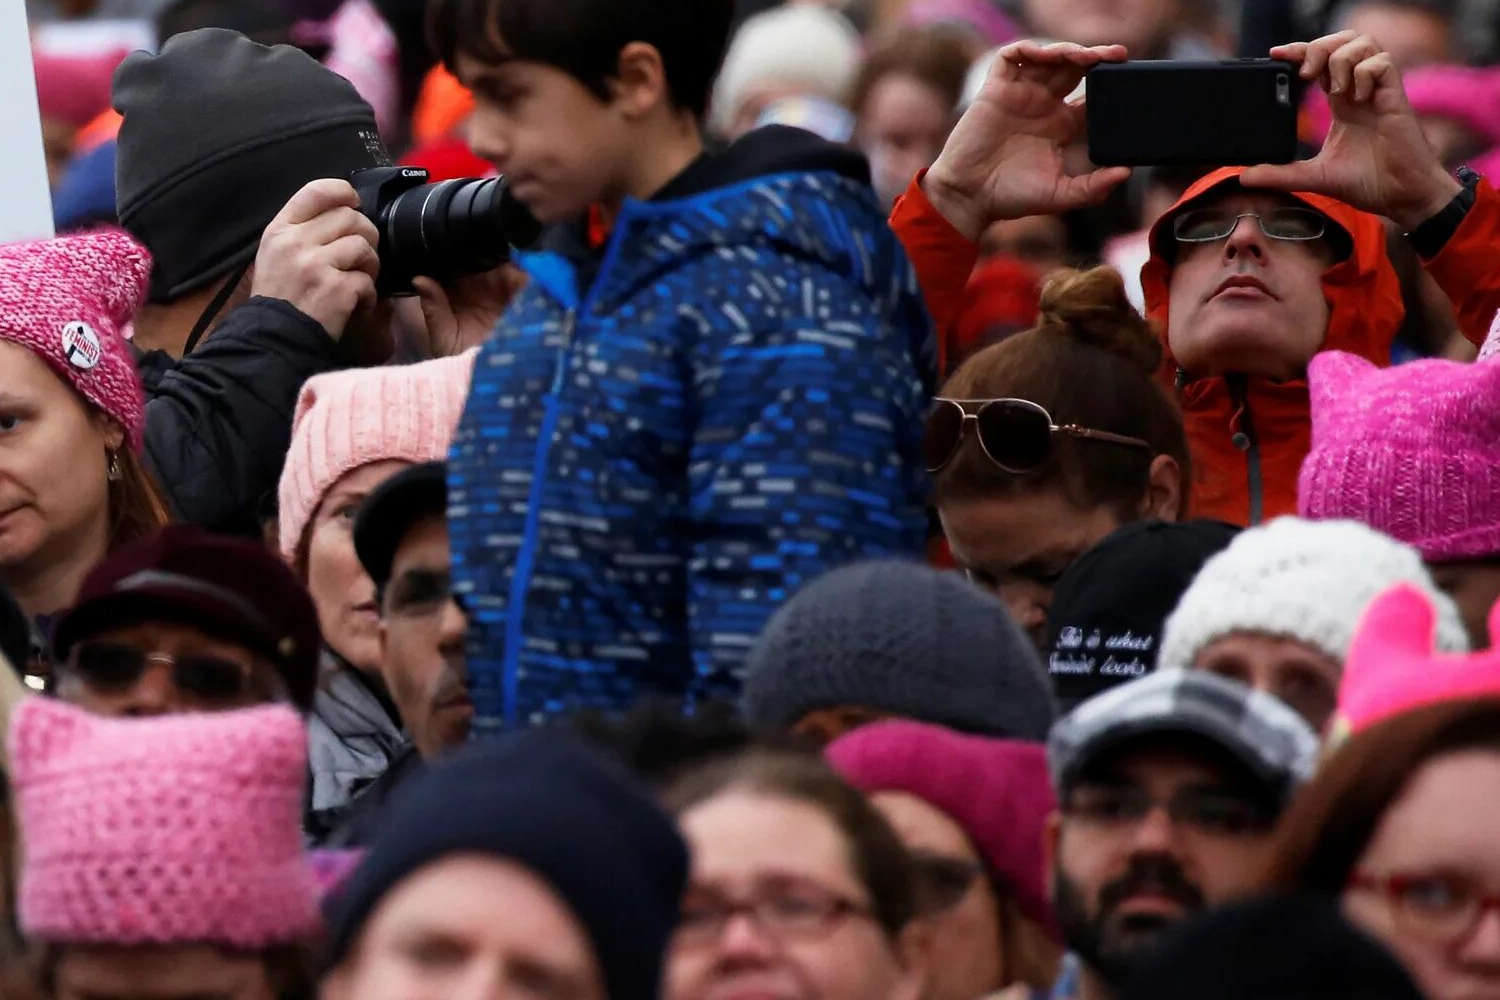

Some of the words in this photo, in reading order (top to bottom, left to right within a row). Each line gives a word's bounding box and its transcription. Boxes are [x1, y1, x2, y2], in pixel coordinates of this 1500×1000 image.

[402, 169, 427, 177] Canon
[65, 328, 99, 361] FEMINIST
[1106, 629, 1154, 650] what
